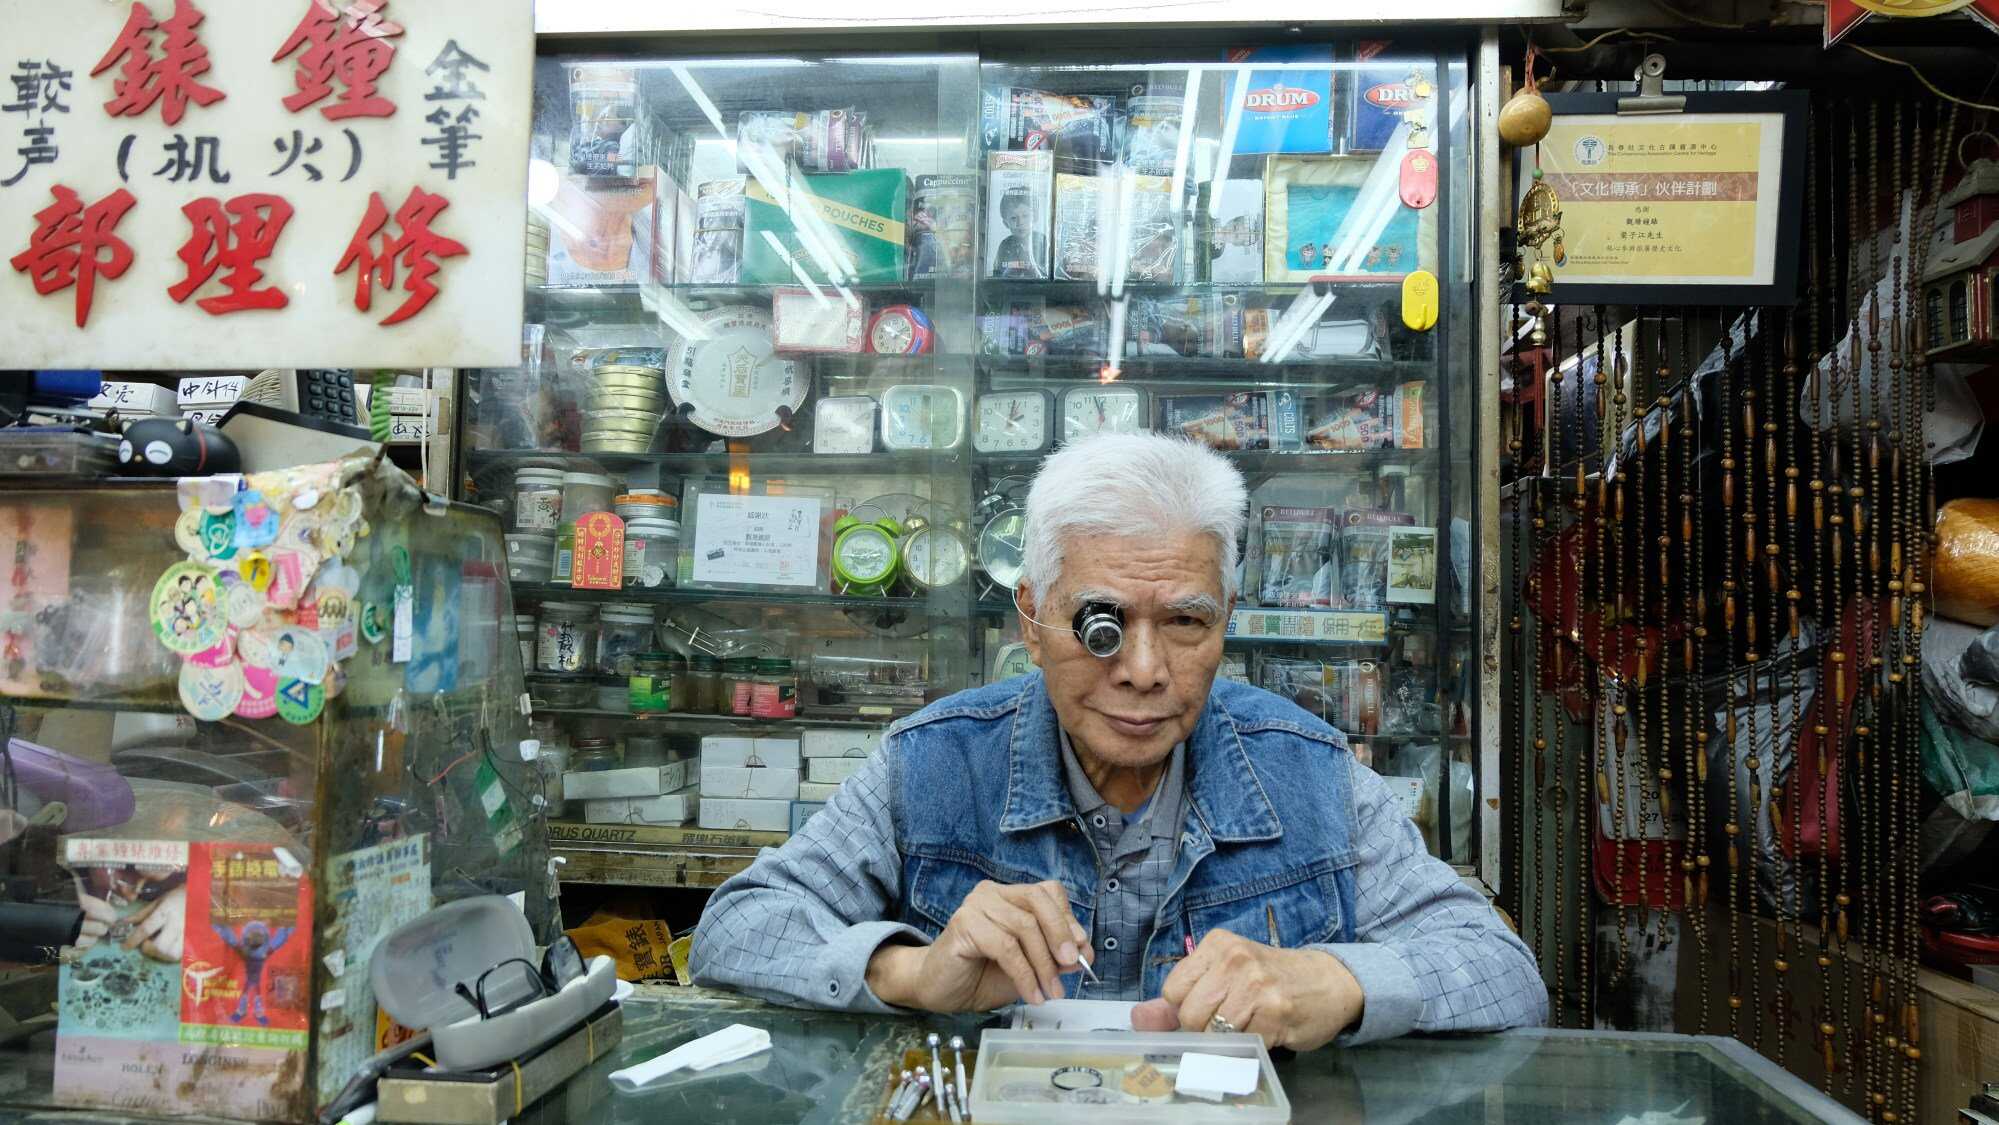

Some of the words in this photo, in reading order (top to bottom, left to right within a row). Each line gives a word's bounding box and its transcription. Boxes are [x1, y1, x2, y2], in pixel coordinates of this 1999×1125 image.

[421, 40, 491, 180] 金筆
[1247, 92, 1308, 107] DRUM
[822, 204, 885, 233] POUCHES
[9, 185, 470, 327] 修理部
[1285, 411, 1296, 434] COLTS
[582, 828, 637, 842] QUARTZ
